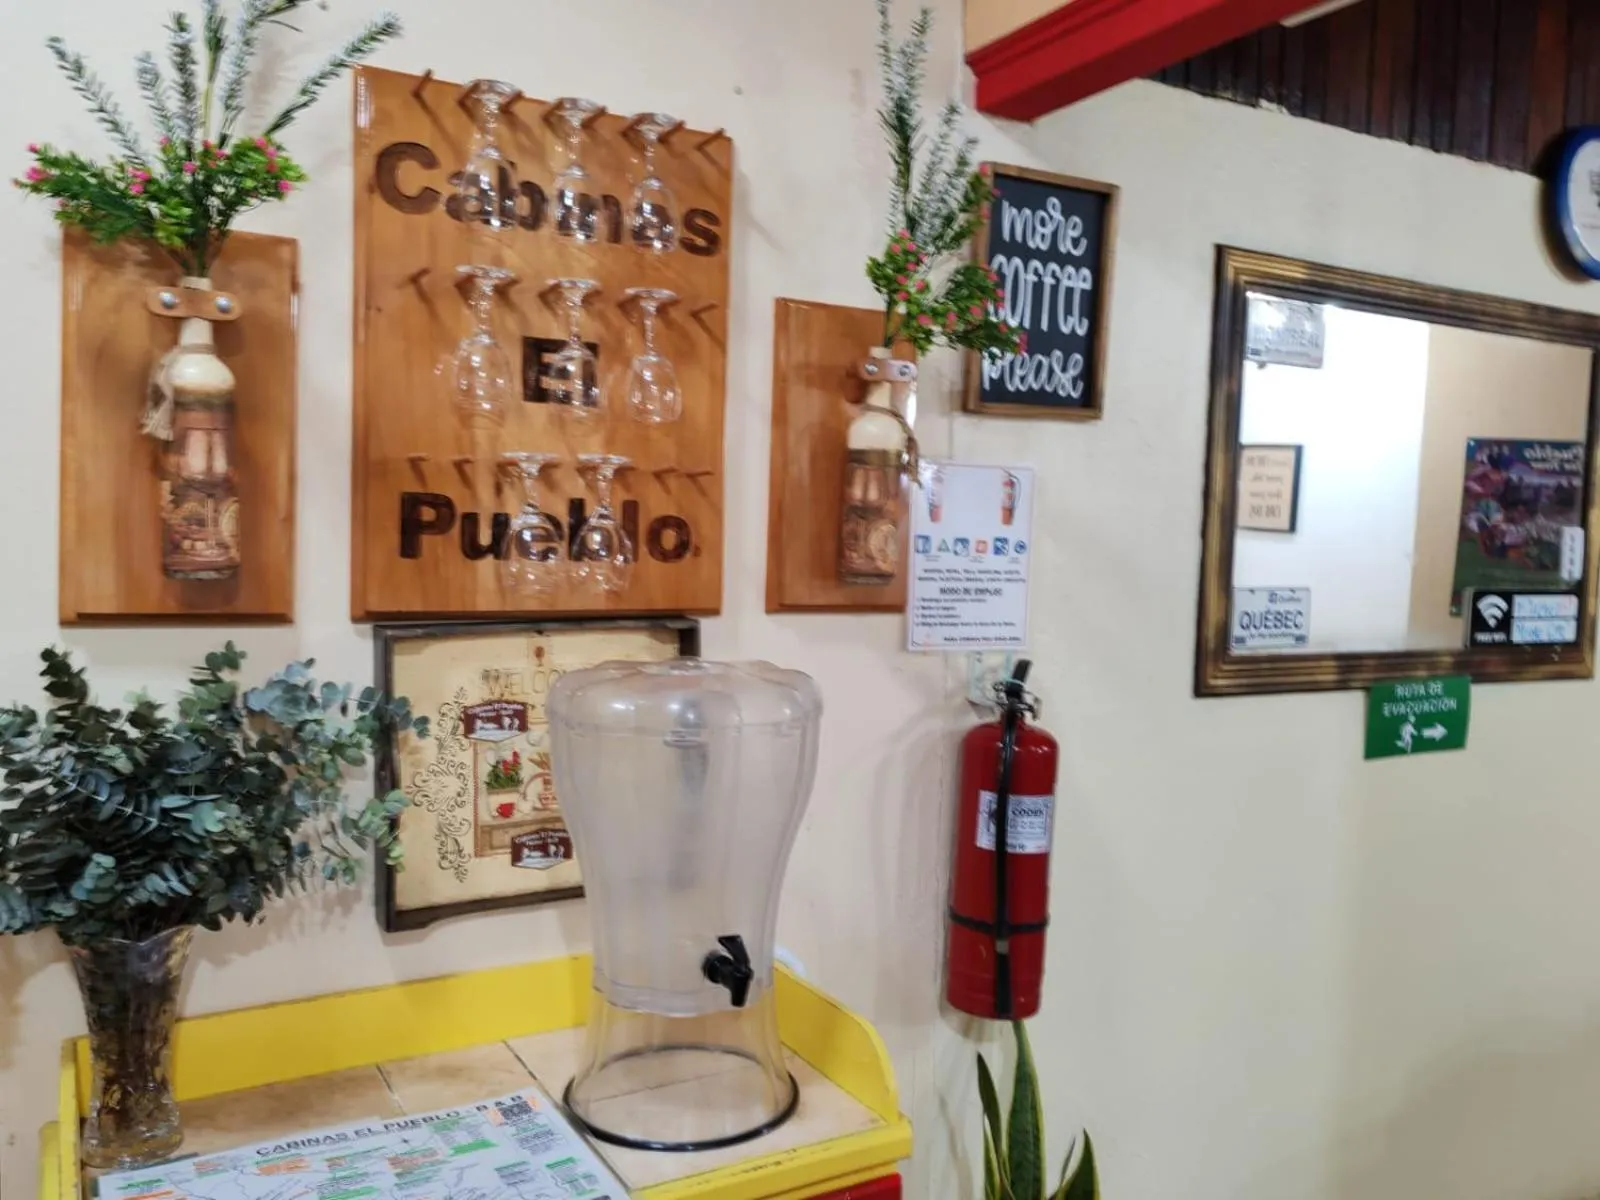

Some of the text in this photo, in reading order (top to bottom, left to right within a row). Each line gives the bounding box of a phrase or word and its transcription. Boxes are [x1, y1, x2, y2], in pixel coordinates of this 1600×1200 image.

[375, 142, 722, 257] Cabinas
[1002, 197, 1088, 257] more
[985, 254, 1093, 336] coffee
[522, 336, 600, 408] El
[1239, 608, 1304, 631] QUÉBEC
[1383, 697, 1458, 717] EVACUACIÓN
[1394, 680, 1444, 699] RUTA DE
[256, 1132, 349, 1157] CABINAS
[353, 1125, 379, 1137] EL
[383, 1110, 460, 1131] PUEBLO
